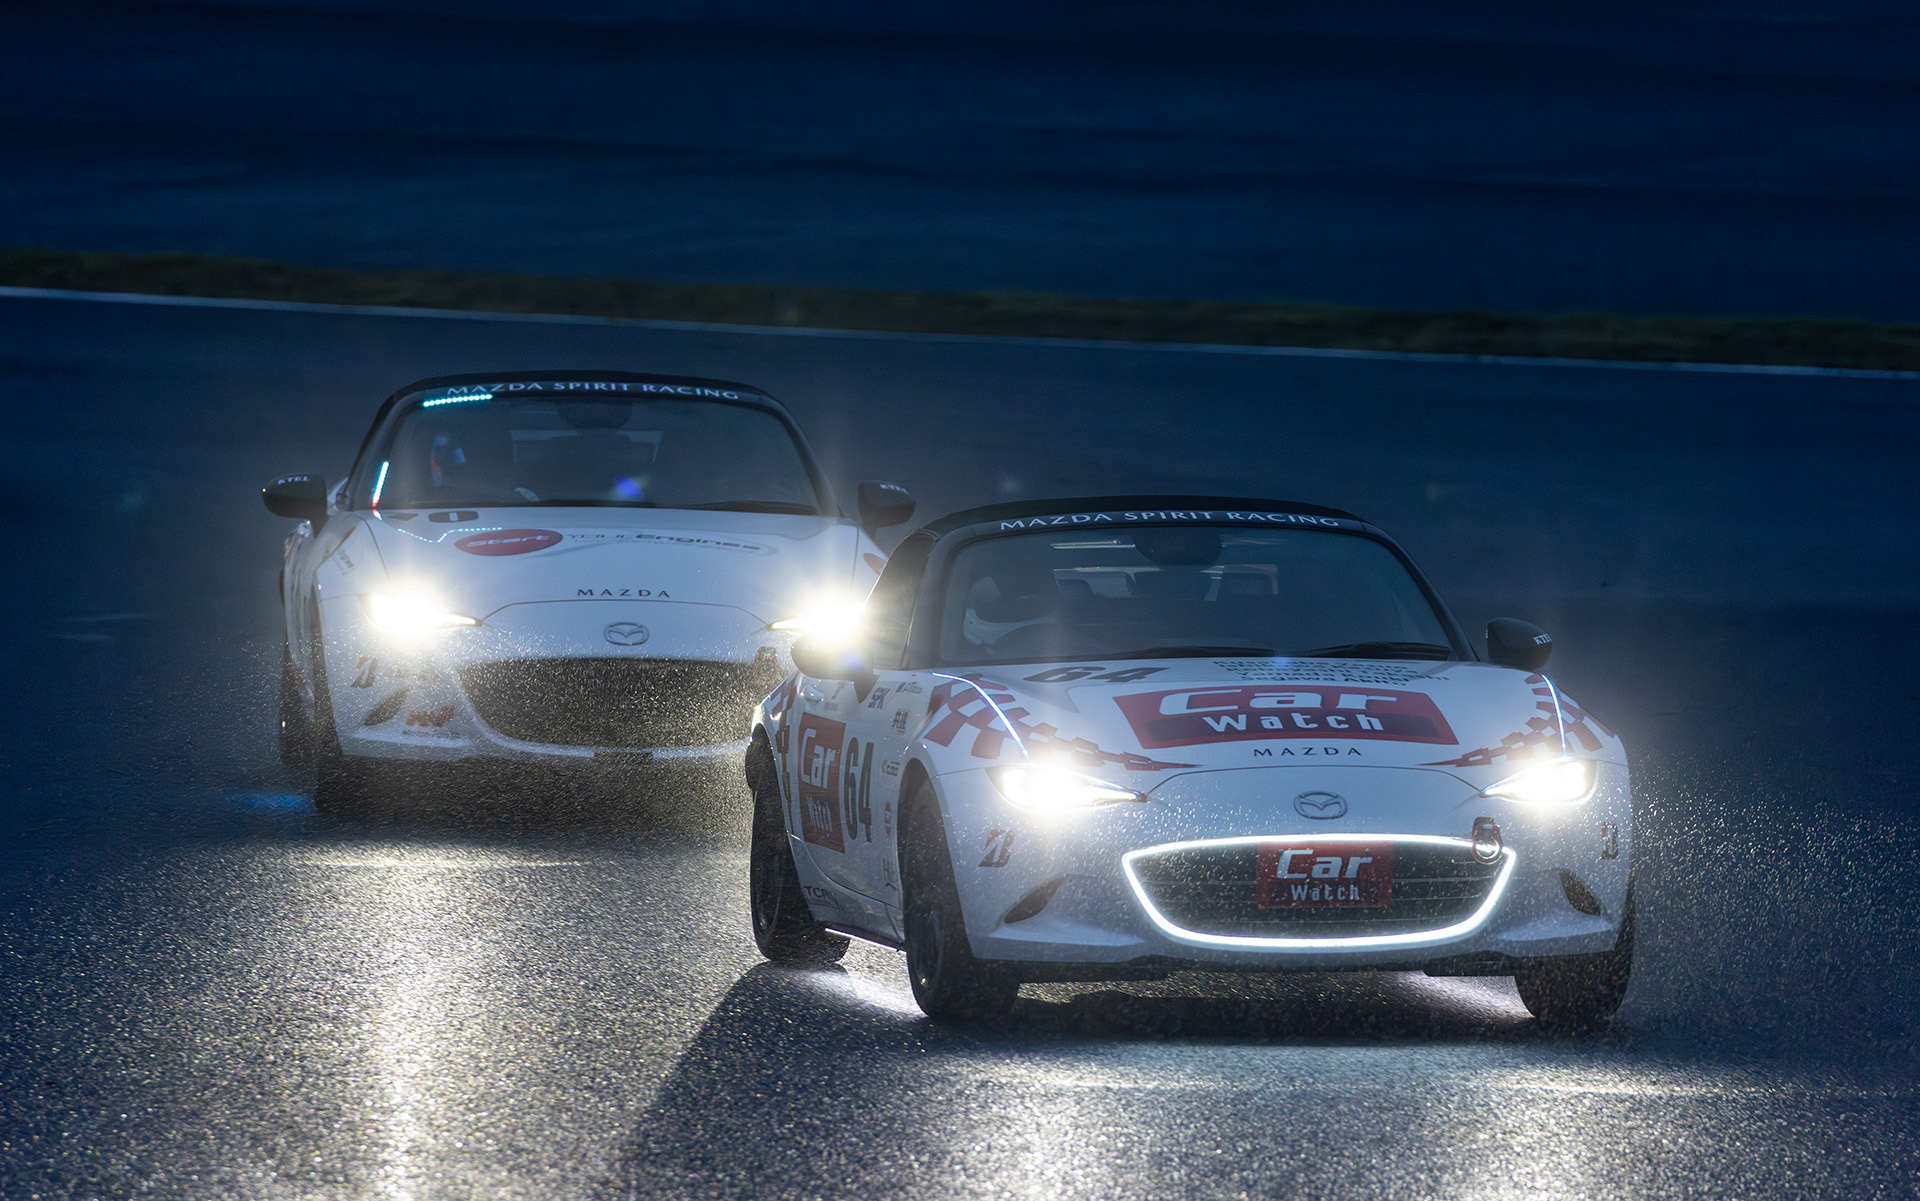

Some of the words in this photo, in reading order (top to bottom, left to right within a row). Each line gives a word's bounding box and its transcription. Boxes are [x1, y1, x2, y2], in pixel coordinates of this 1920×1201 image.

[447, 382, 543, 395] MAZDA
[553, 381, 630, 391] SPIRIT
[642, 384, 739, 399] RACING
[1000, 512, 1113, 531] MAZDA
[1124, 511, 1213, 521] SPIRIT
[1226, 512, 1340, 527] RACING
[577, 588, 671, 599] MAZDA
[1022, 666, 1171, 683] 64
[1158, 689, 1398, 715] Car
[1202, 711, 1385, 732] Watch
[801, 728, 837, 790] Car
[1253, 746, 1362, 757] MAZDA
[843, 737, 875, 843] 64
[1276, 849, 1373, 879] Car
[1290, 884, 1360, 901] Watch
